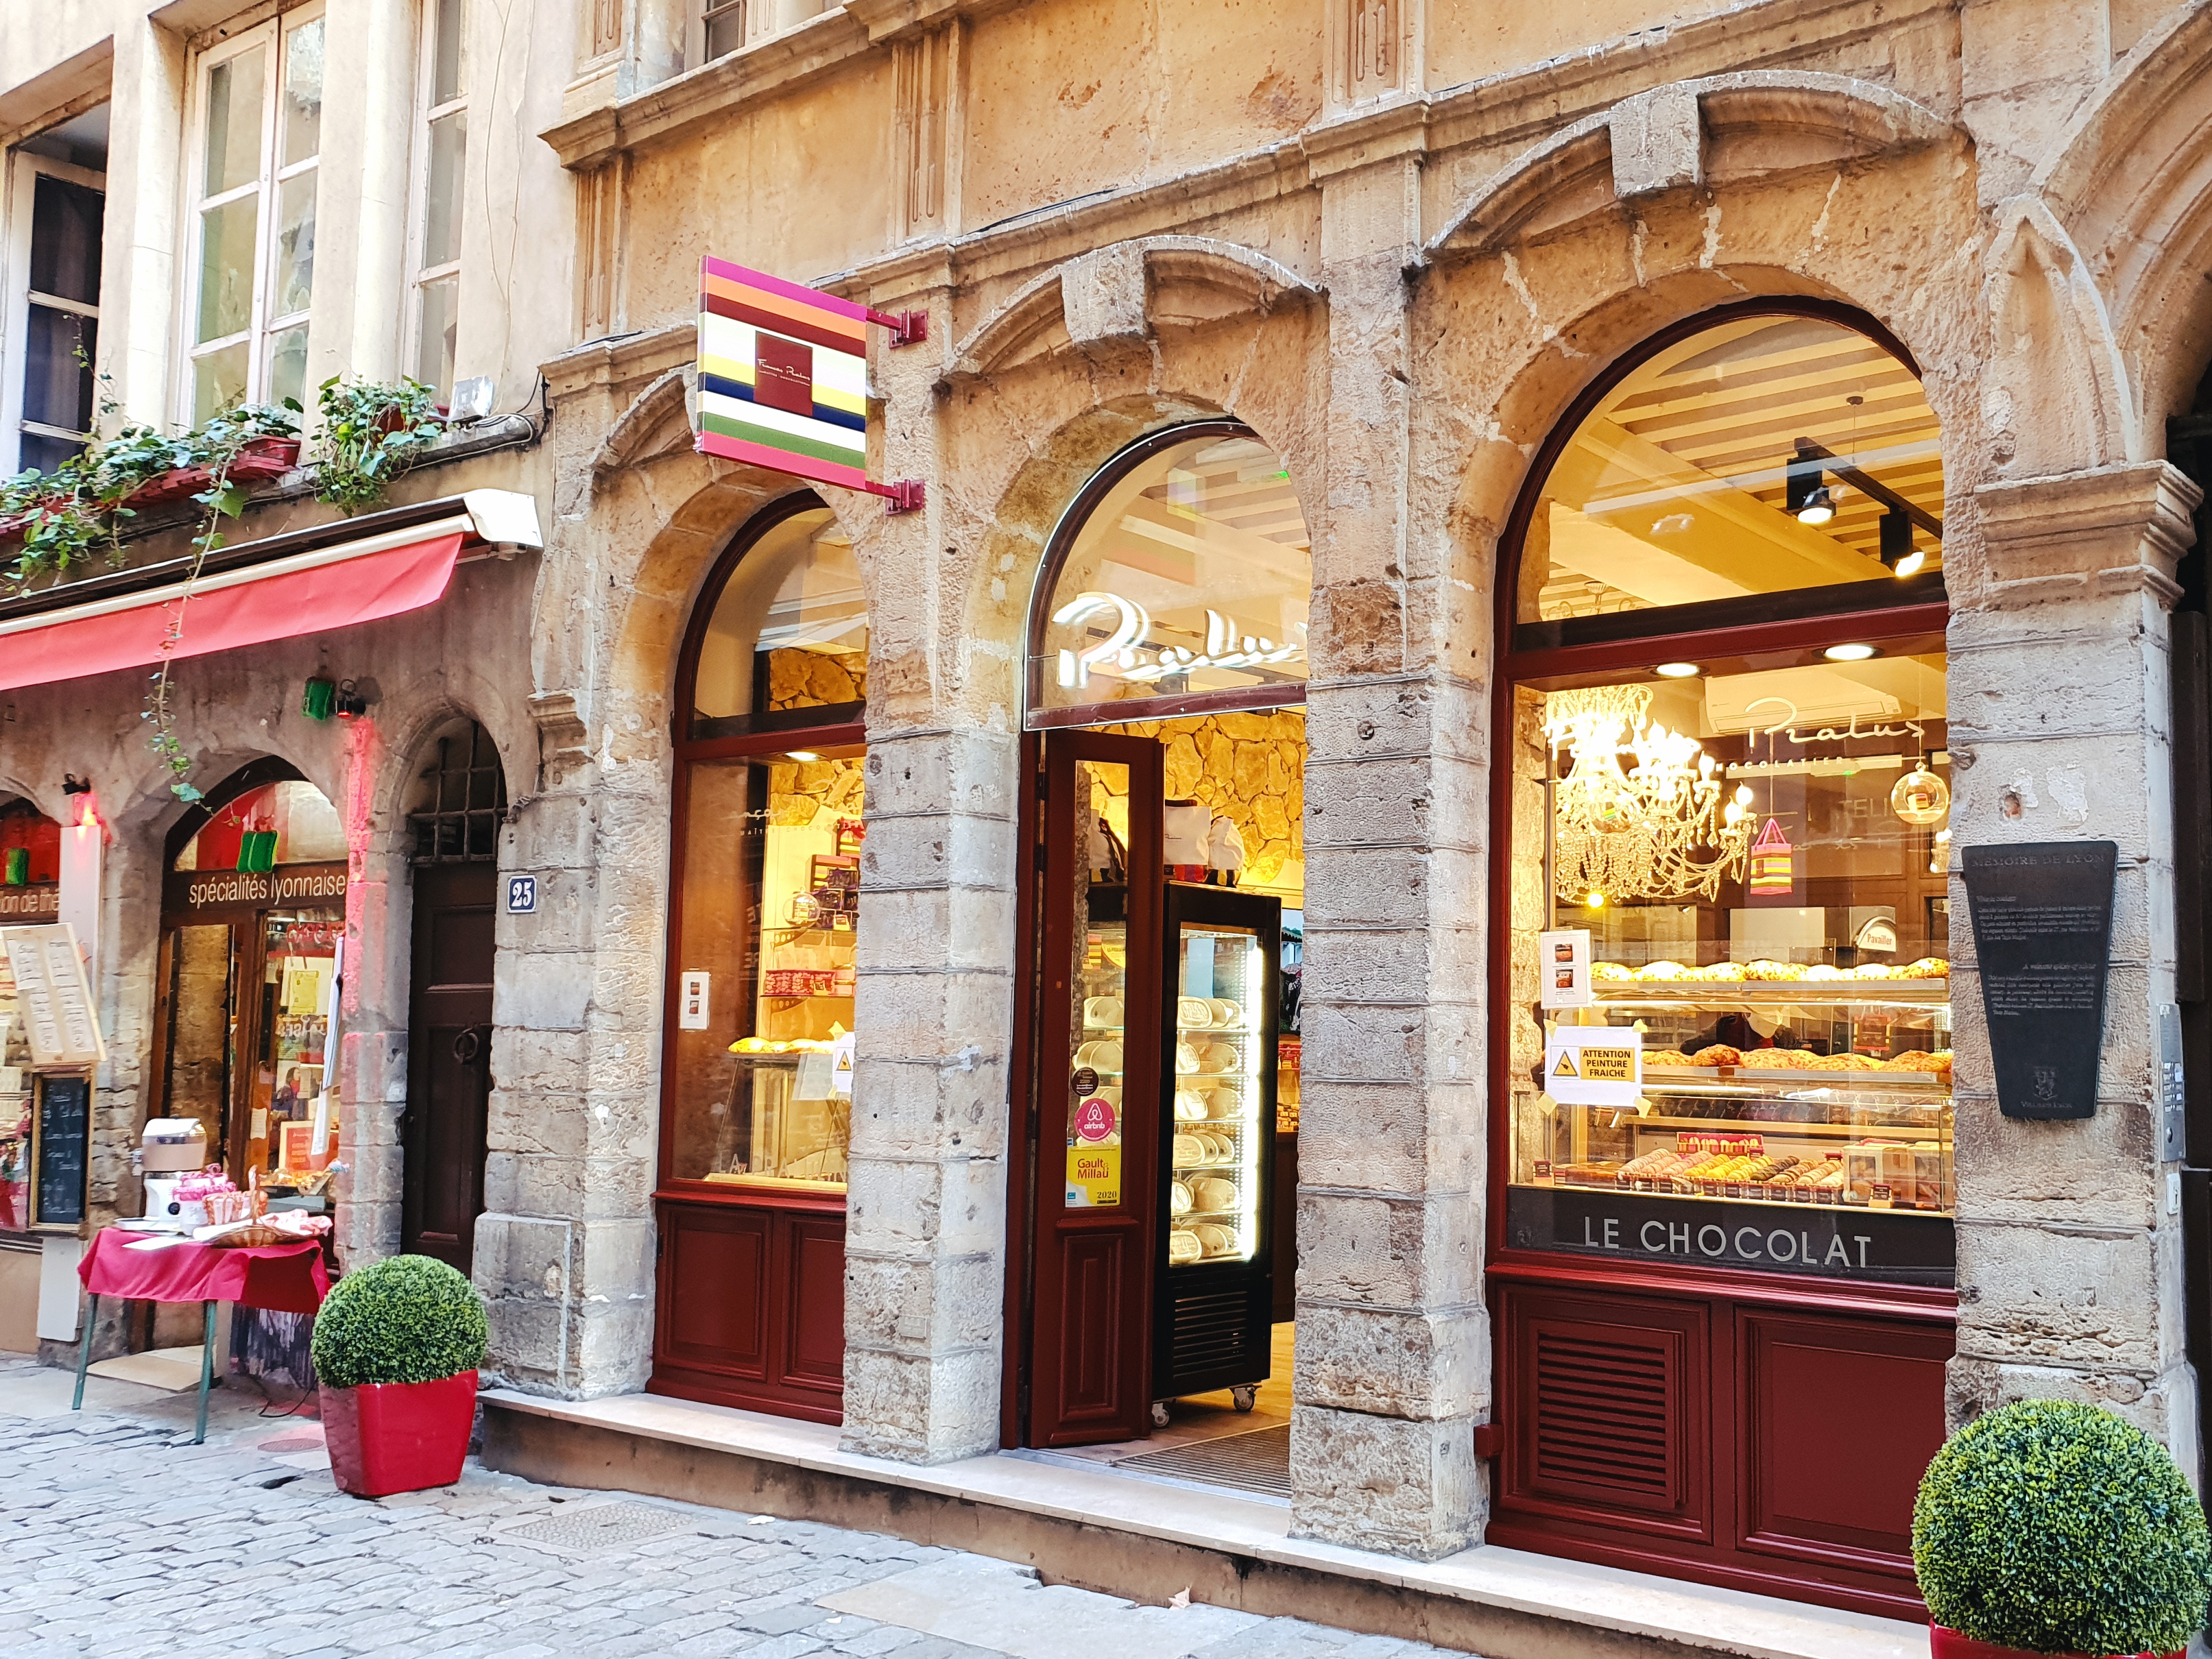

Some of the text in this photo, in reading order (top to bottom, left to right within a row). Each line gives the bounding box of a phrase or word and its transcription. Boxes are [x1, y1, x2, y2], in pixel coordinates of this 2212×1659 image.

[1745, 697, 1925, 749] Pralus
[1715, 756, 1844, 772] HOCOLATIER
[189, 873, 267, 910] spécialités
[512, 882, 532, 907] 25
[20, 888, 38, 912] de
[1583, 1050, 1631, 1058] ATTENTION
[1586, 1059, 1628, 1067] PEINTURE
[1589, 1069, 1626, 1078] FRAICHE
[1083, 1122, 1105, 1130] airbnb
[1077, 1158, 1103, 1168] Gault
[1077, 1168, 1109, 1179] Millau
[1097, 1191, 1117, 1199] 2020
[1585, 1215, 1872, 1268] LE CHOCOLAT
